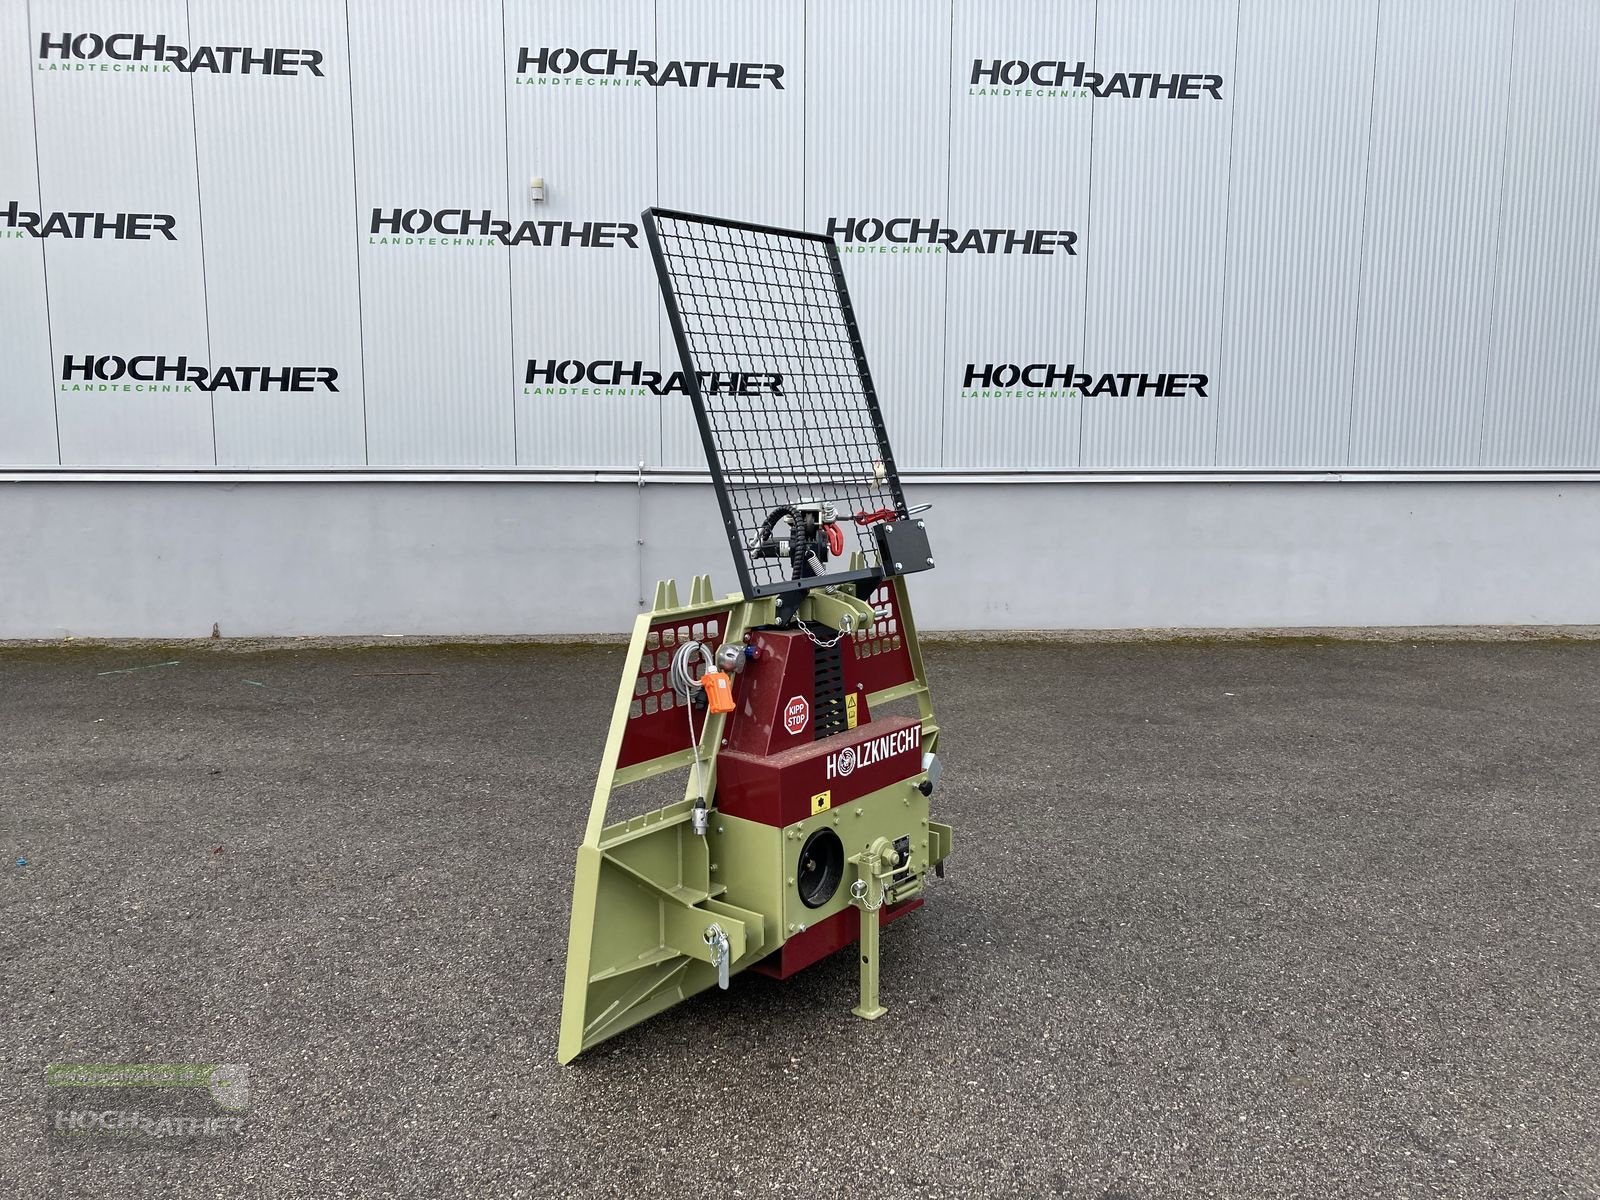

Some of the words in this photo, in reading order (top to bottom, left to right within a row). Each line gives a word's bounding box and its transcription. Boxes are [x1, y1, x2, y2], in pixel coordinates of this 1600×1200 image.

[40, 33, 325, 77] HOCHRATHER
[38, 63, 171, 73] LANDTECHNIK
[517, 47, 785, 90] HOCHRATHER
[516, 77, 641, 87] LANDTECHNIK
[970, 59, 1223, 100] HOCHRATHER
[969, 88, 1088, 97] LANDTECHNIK
[371, 208, 639, 249] HOCHRATHER
[369, 237, 495, 247] LANDTECHNIK
[826, 217, 1078, 256] HOCHRATHER
[836, 245, 943, 254] NDTECHNIK
[63, 354, 340, 393] HOCHRATHER
[962, 363, 1209, 398] HOCHRATHER
[61, 383, 193, 393] LANDTECHNIK
[524, 387, 647, 397] LANDTECHNIK
[961, 389, 1078, 399] LANDTECHNIK
[789, 703, 805, 716] KIPP
[788, 714, 806, 727] STOP
[826, 725, 922, 780] HOLZKNECHT
